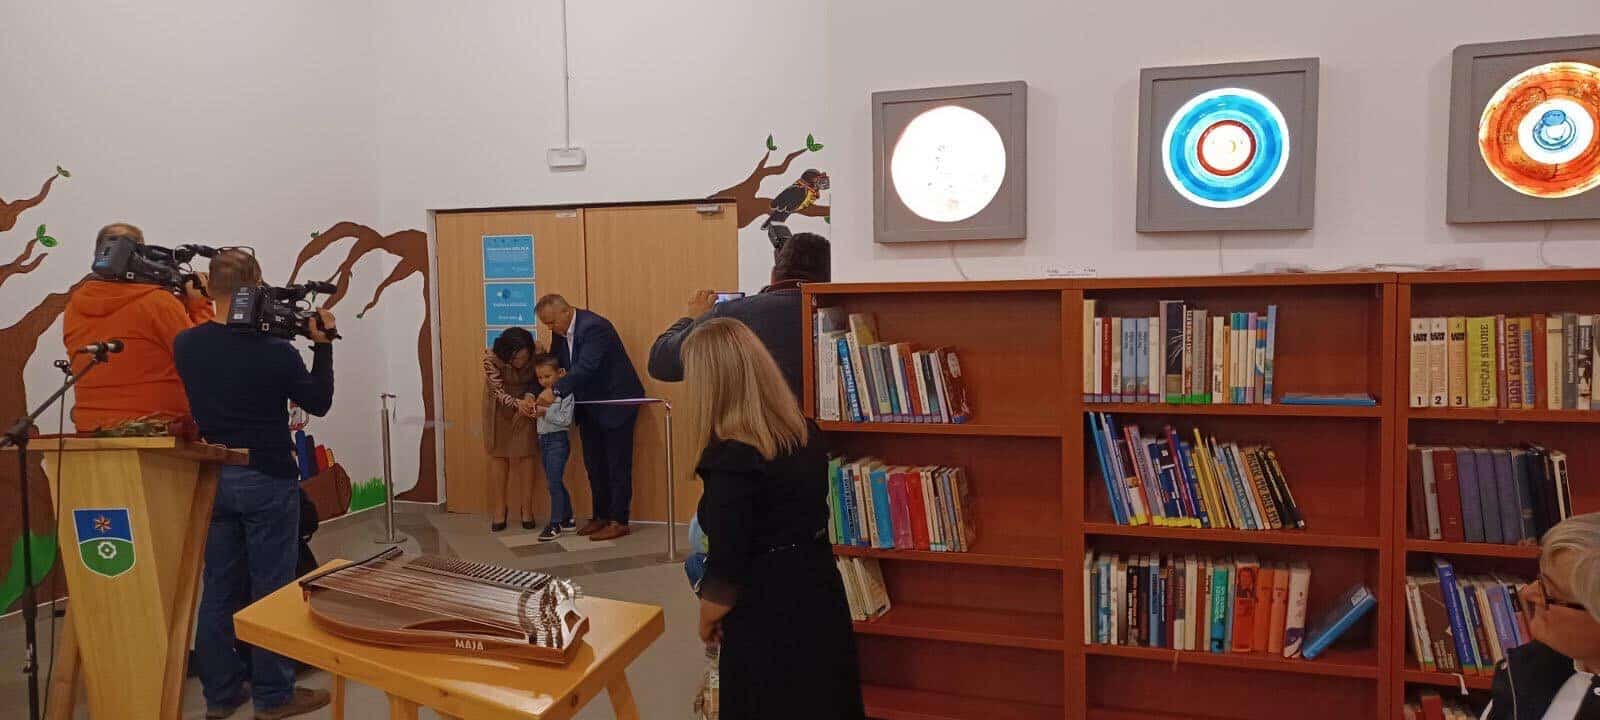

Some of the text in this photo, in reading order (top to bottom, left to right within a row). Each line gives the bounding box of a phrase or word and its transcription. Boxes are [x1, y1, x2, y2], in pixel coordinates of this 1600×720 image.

[1416, 396, 1422, 405] 1
[1435, 396, 1442, 405] 2
[1456, 396, 1462, 405] 3
[455, 639, 484, 650] MAJA
